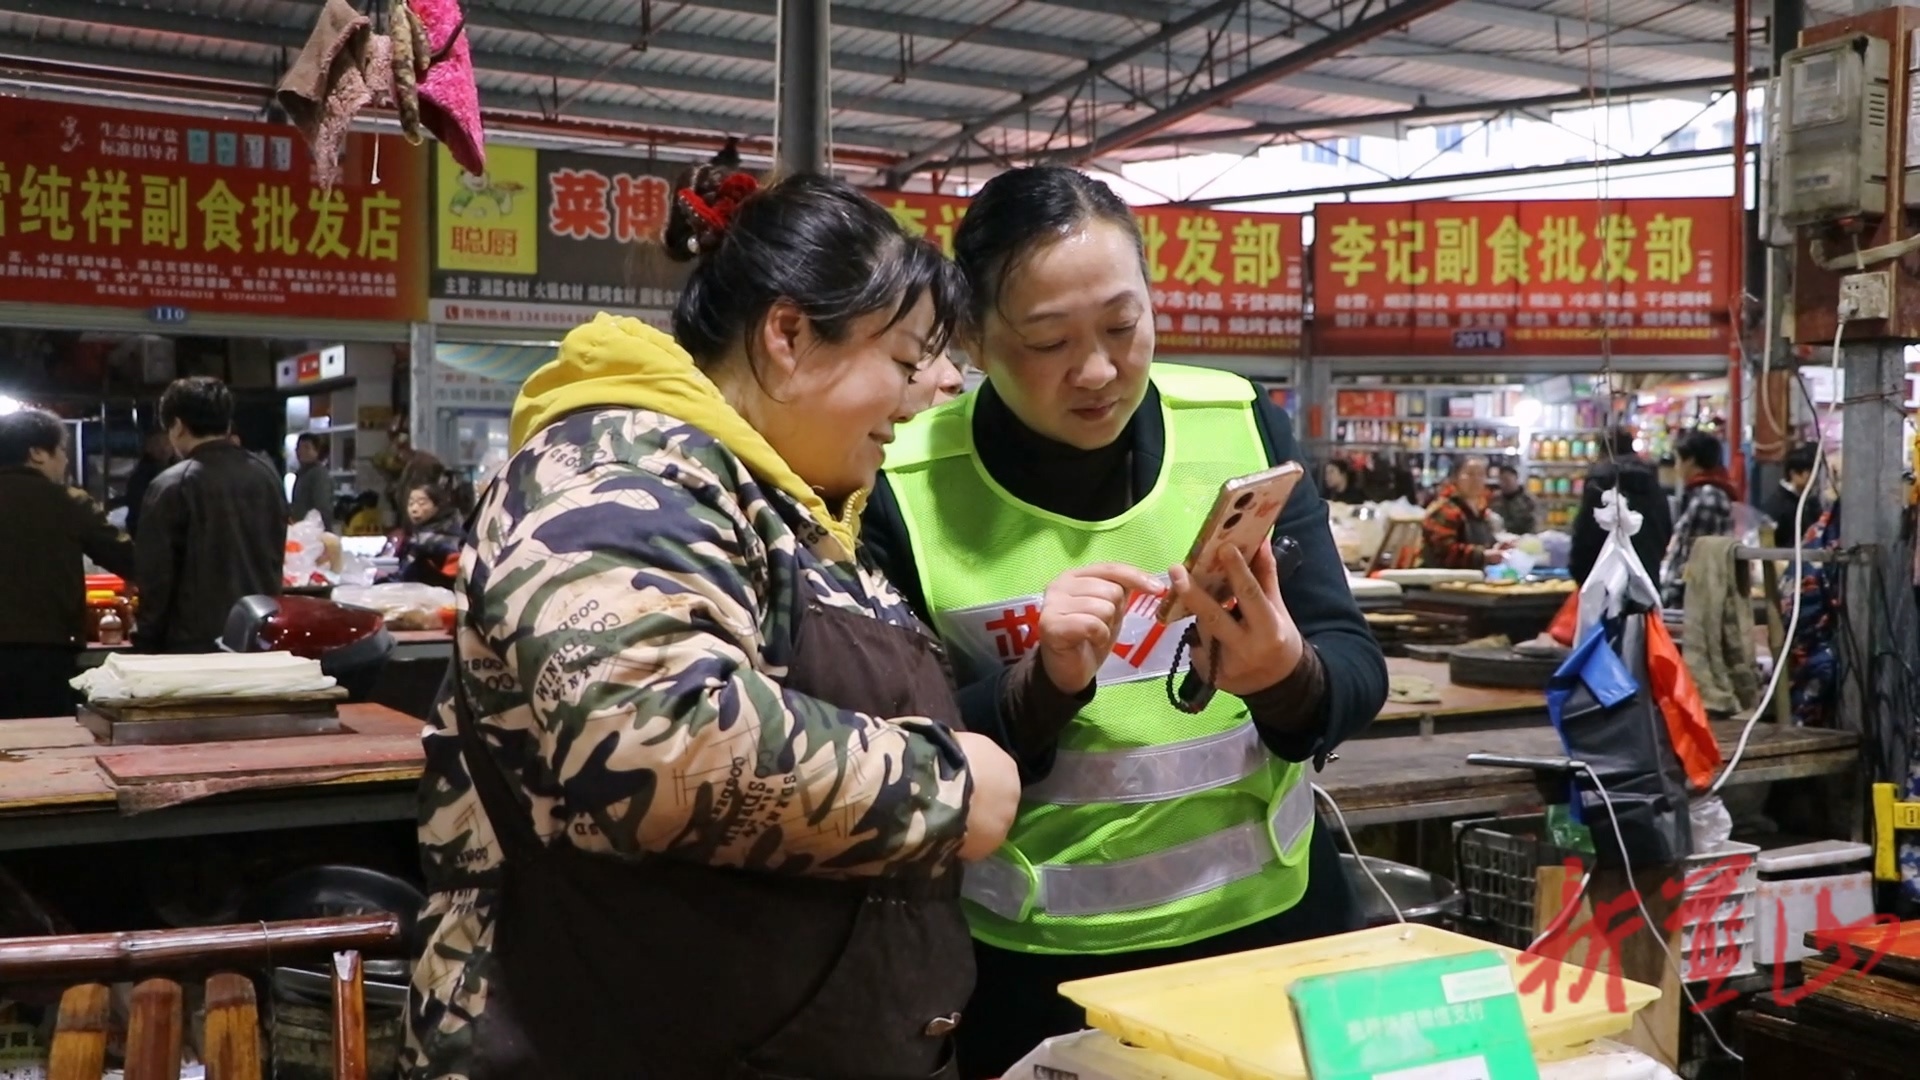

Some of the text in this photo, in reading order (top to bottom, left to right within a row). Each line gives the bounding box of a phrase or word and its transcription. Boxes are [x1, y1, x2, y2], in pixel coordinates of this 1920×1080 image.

[0, 165, 401, 261] 纯祥副食批发店
[451, 226, 518, 257] 聪厨
[1330, 213, 1694, 288] 李记副食批发部
[155, 307, 186, 322] 110
